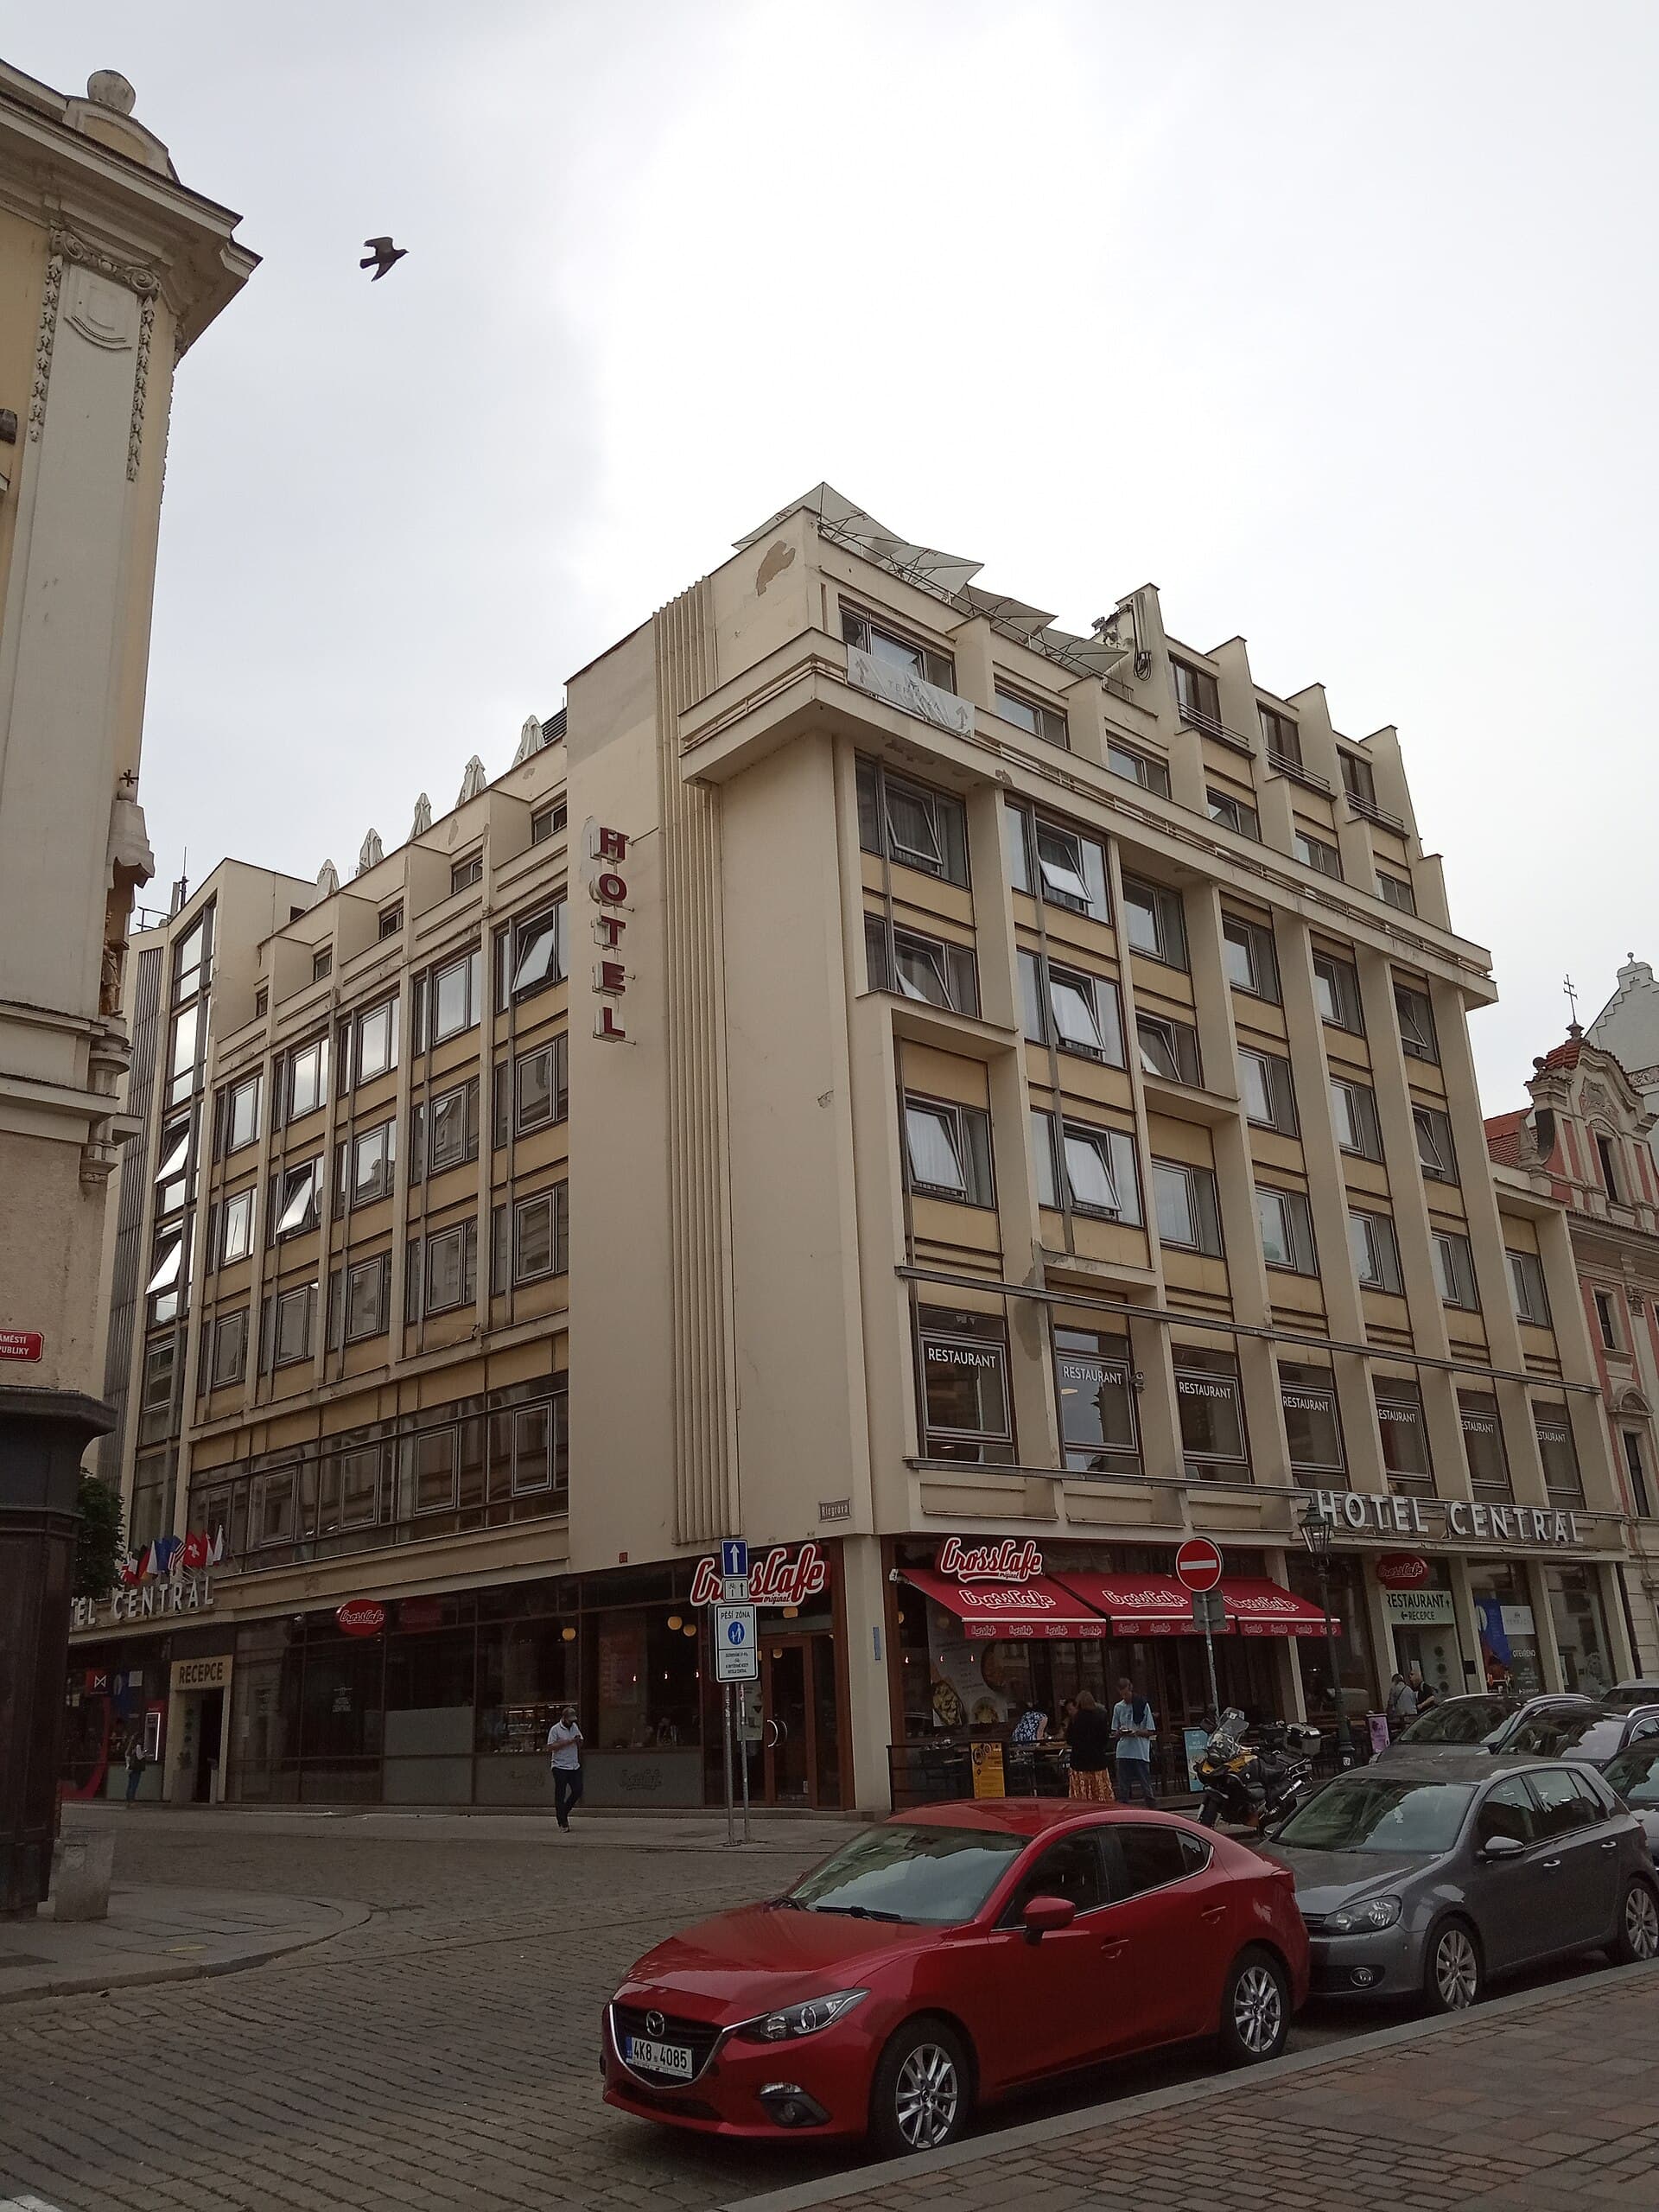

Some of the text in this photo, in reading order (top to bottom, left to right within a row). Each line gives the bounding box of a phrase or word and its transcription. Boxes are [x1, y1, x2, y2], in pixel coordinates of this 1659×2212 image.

[596, 826, 627, 1039] HOTEL
[0, 1345, 29, 1356] UBLIKY
[928, 1347, 996, 1369] RESTAURANT
[1063, 1365, 1122, 1385] RESTAURANT
[1179, 1382, 1231, 1399] RESTAURANT
[1282, 1395, 1329, 1413] RESTAURANT
[1376, 1408, 1416, 1424] ESTAURANT
[1460, 1420, 1495, 1434] ESTAURANT
[1535, 1431, 1566, 1444] ESTAURANT
[1316, 1490, 1585, 1543] HOTEL CENTRAL
[940, 1537, 1044, 1582] CrossCafe
[113, 1576, 215, 1620] CENTRAL
[1386, 1593, 1444, 1608] RESTAURANT
[735, 1609, 751, 1619] ZÓNA
[1408, 1611, 1436, 1620] RECEPCE
[178, 1662, 224, 1684] RECEPCE
[634, 2040, 688, 2069] 4K8 4085
